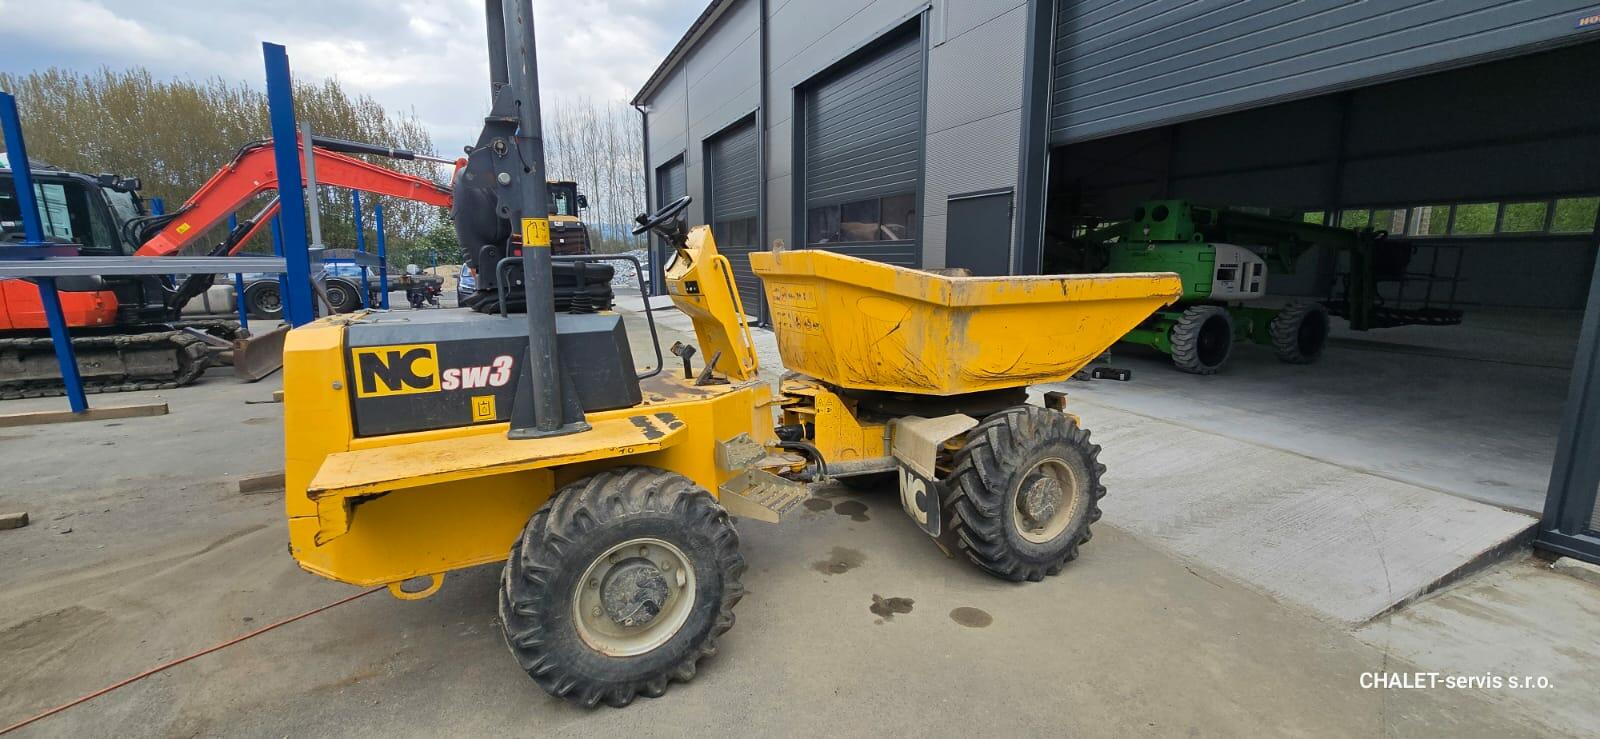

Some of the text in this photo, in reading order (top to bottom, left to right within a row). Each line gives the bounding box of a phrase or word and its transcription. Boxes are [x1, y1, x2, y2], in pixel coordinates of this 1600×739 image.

[1579, 15, 1600, 26] HO
[358, 348, 434, 393] NC
[899, 465, 928, 524] NC
